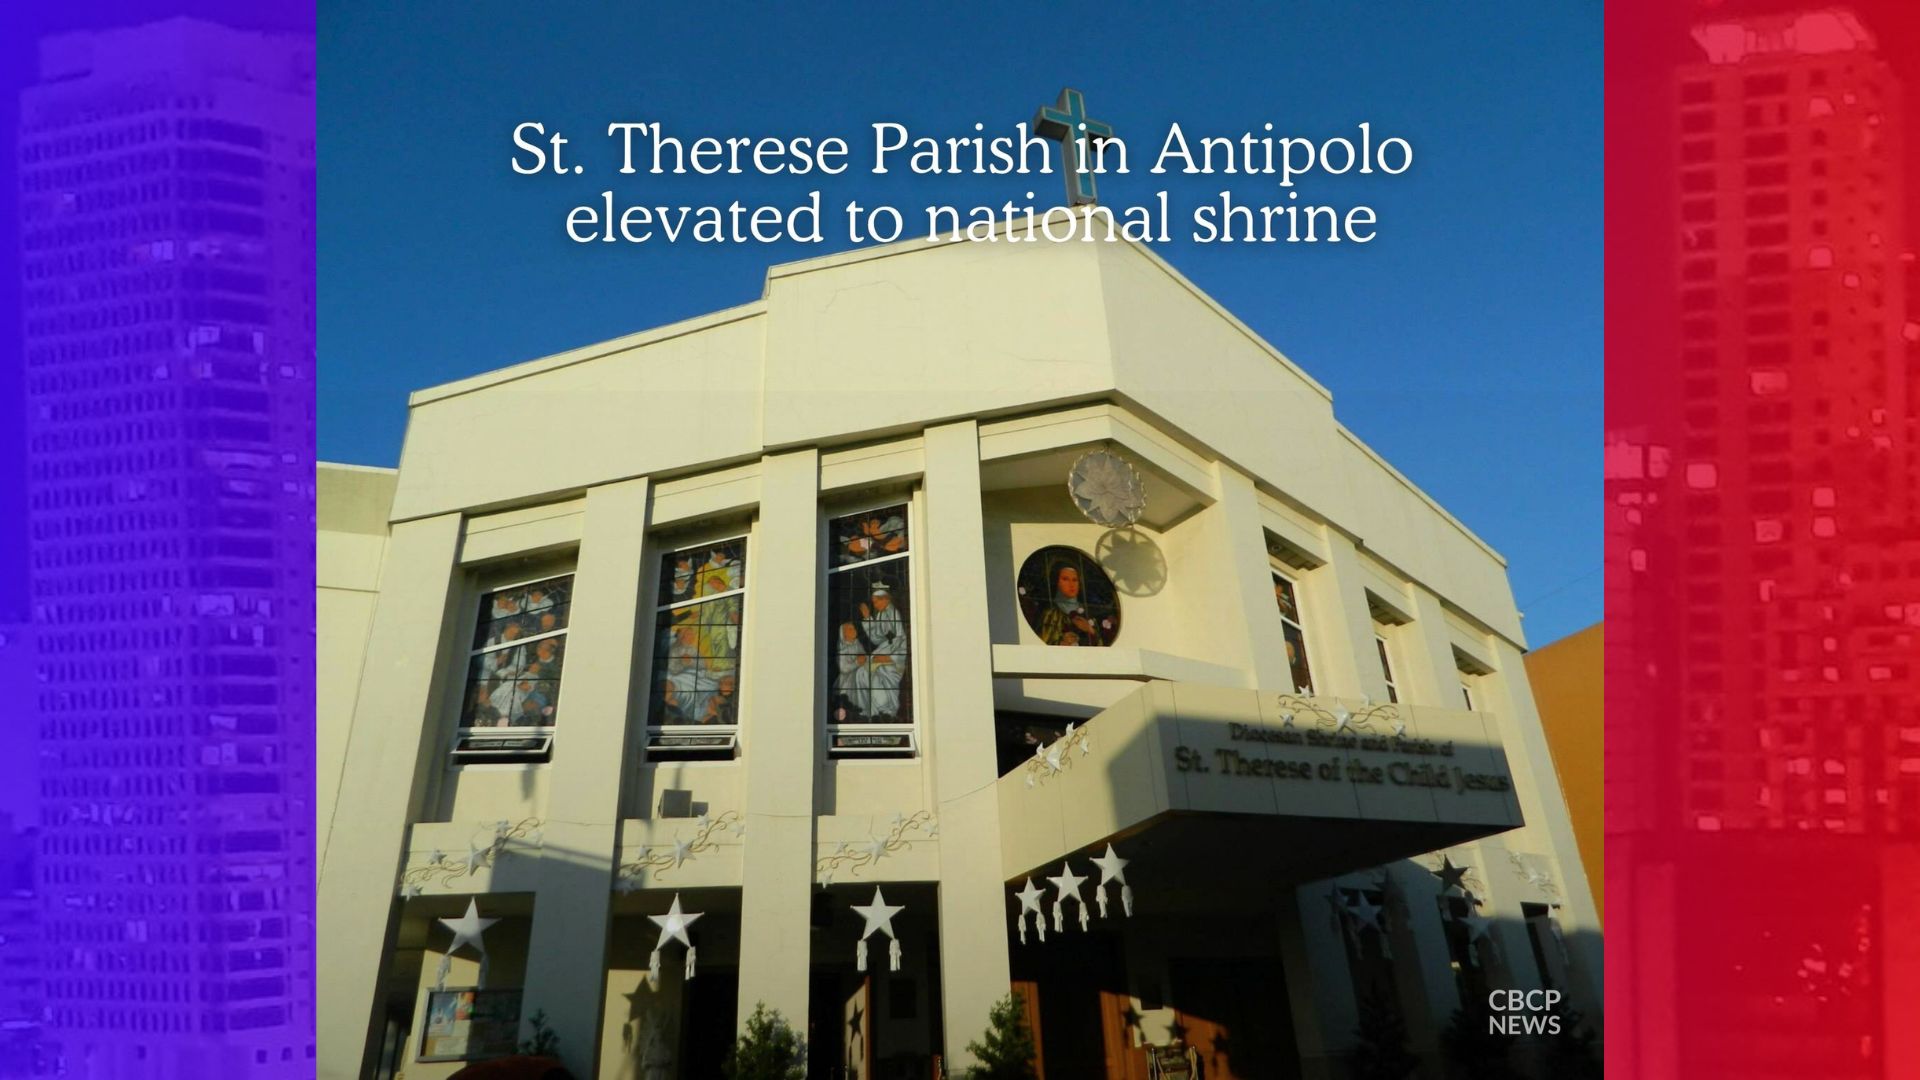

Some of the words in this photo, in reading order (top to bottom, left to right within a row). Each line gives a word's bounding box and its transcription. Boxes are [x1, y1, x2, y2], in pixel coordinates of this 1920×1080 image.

[1175, 746, 1209, 773] St.
[1215, 748, 1312, 780] Therese
[1318, 756, 1341, 782] of
[1346, 758, 1383, 784] the
[1388, 762, 1451, 788] Child
[1454, 766, 1508, 795] Jesus
